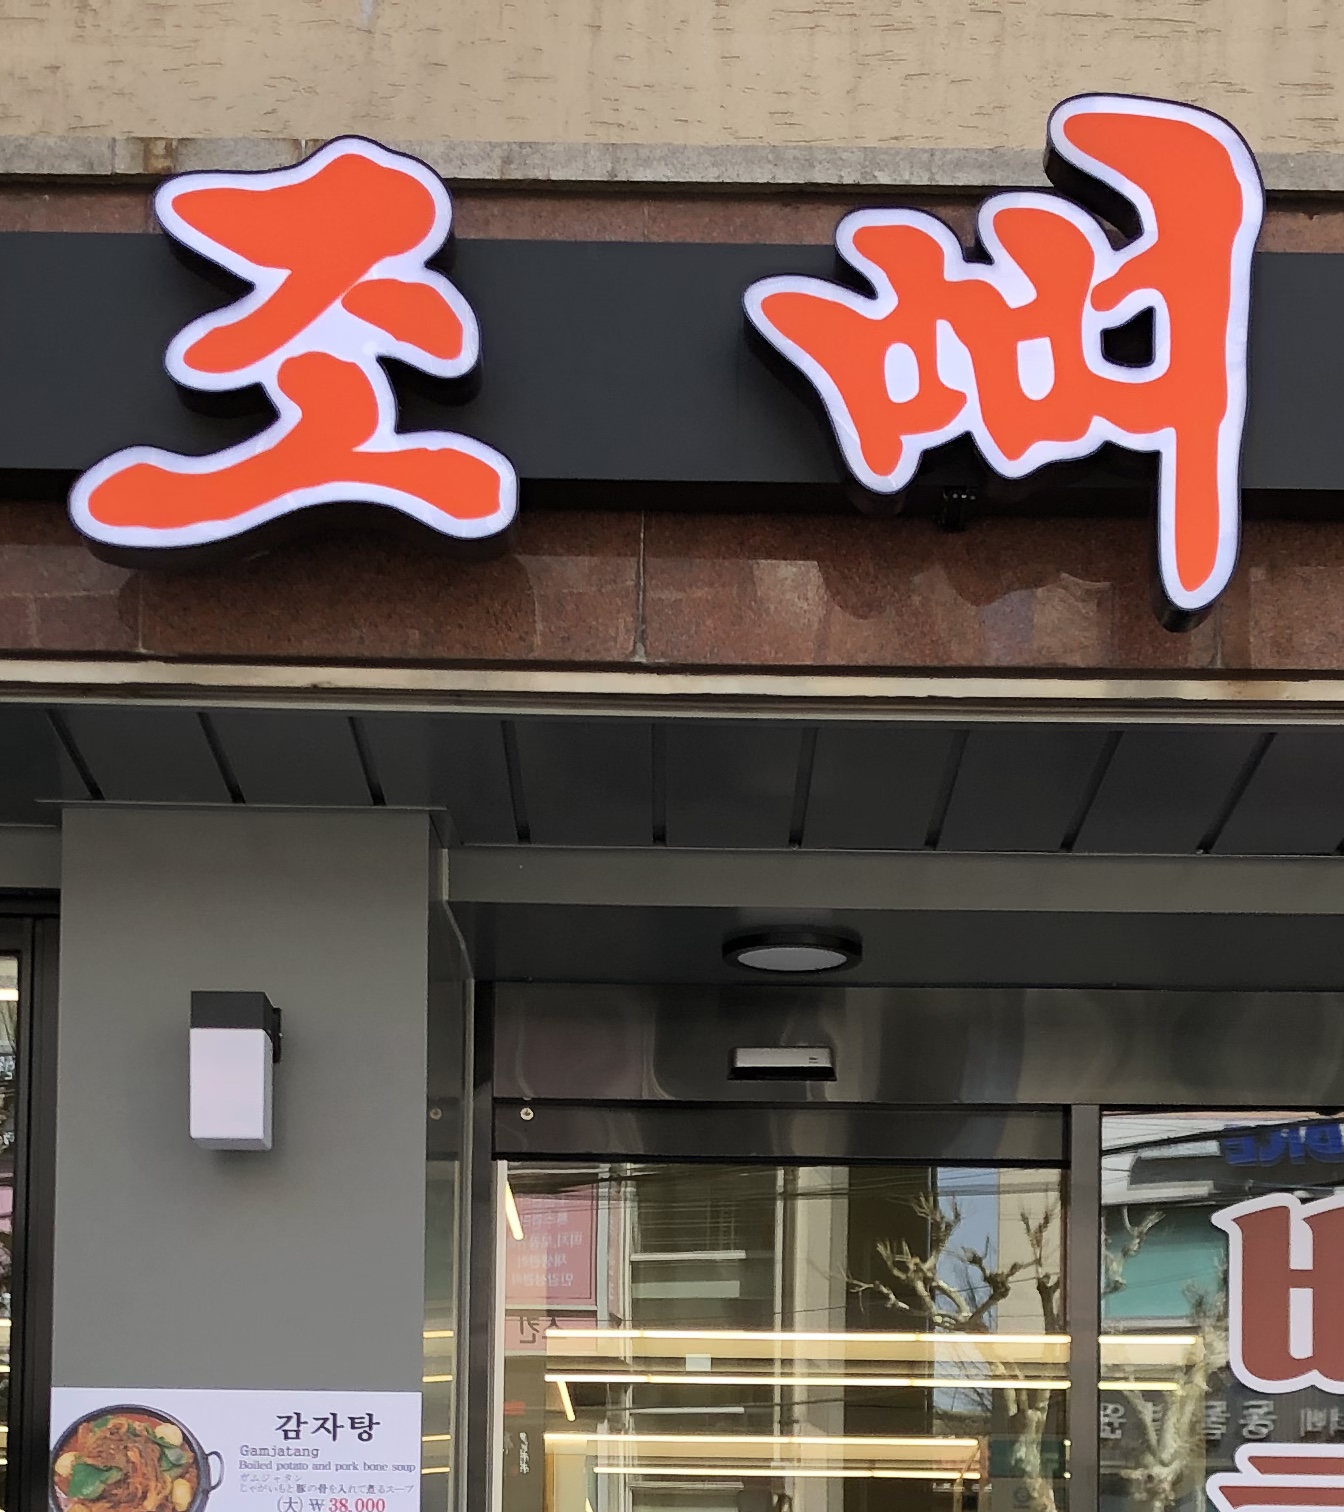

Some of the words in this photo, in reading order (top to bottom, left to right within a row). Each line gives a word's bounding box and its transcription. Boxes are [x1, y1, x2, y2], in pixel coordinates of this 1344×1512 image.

[275, 1412, 381, 1442] 감자탕
[240, 1445, 320, 1458] Gamjatang
[239, 1460, 272, 1470] Boiled
[276, 1460, 308, 1472] potato
[312, 1461, 331, 1471] and
[335, 1461, 359, 1472] pork
[363, 1462, 388, 1472] bone
[392, 1463, 416, 1473] soup
[277, 1497, 303, 1512] (大)
